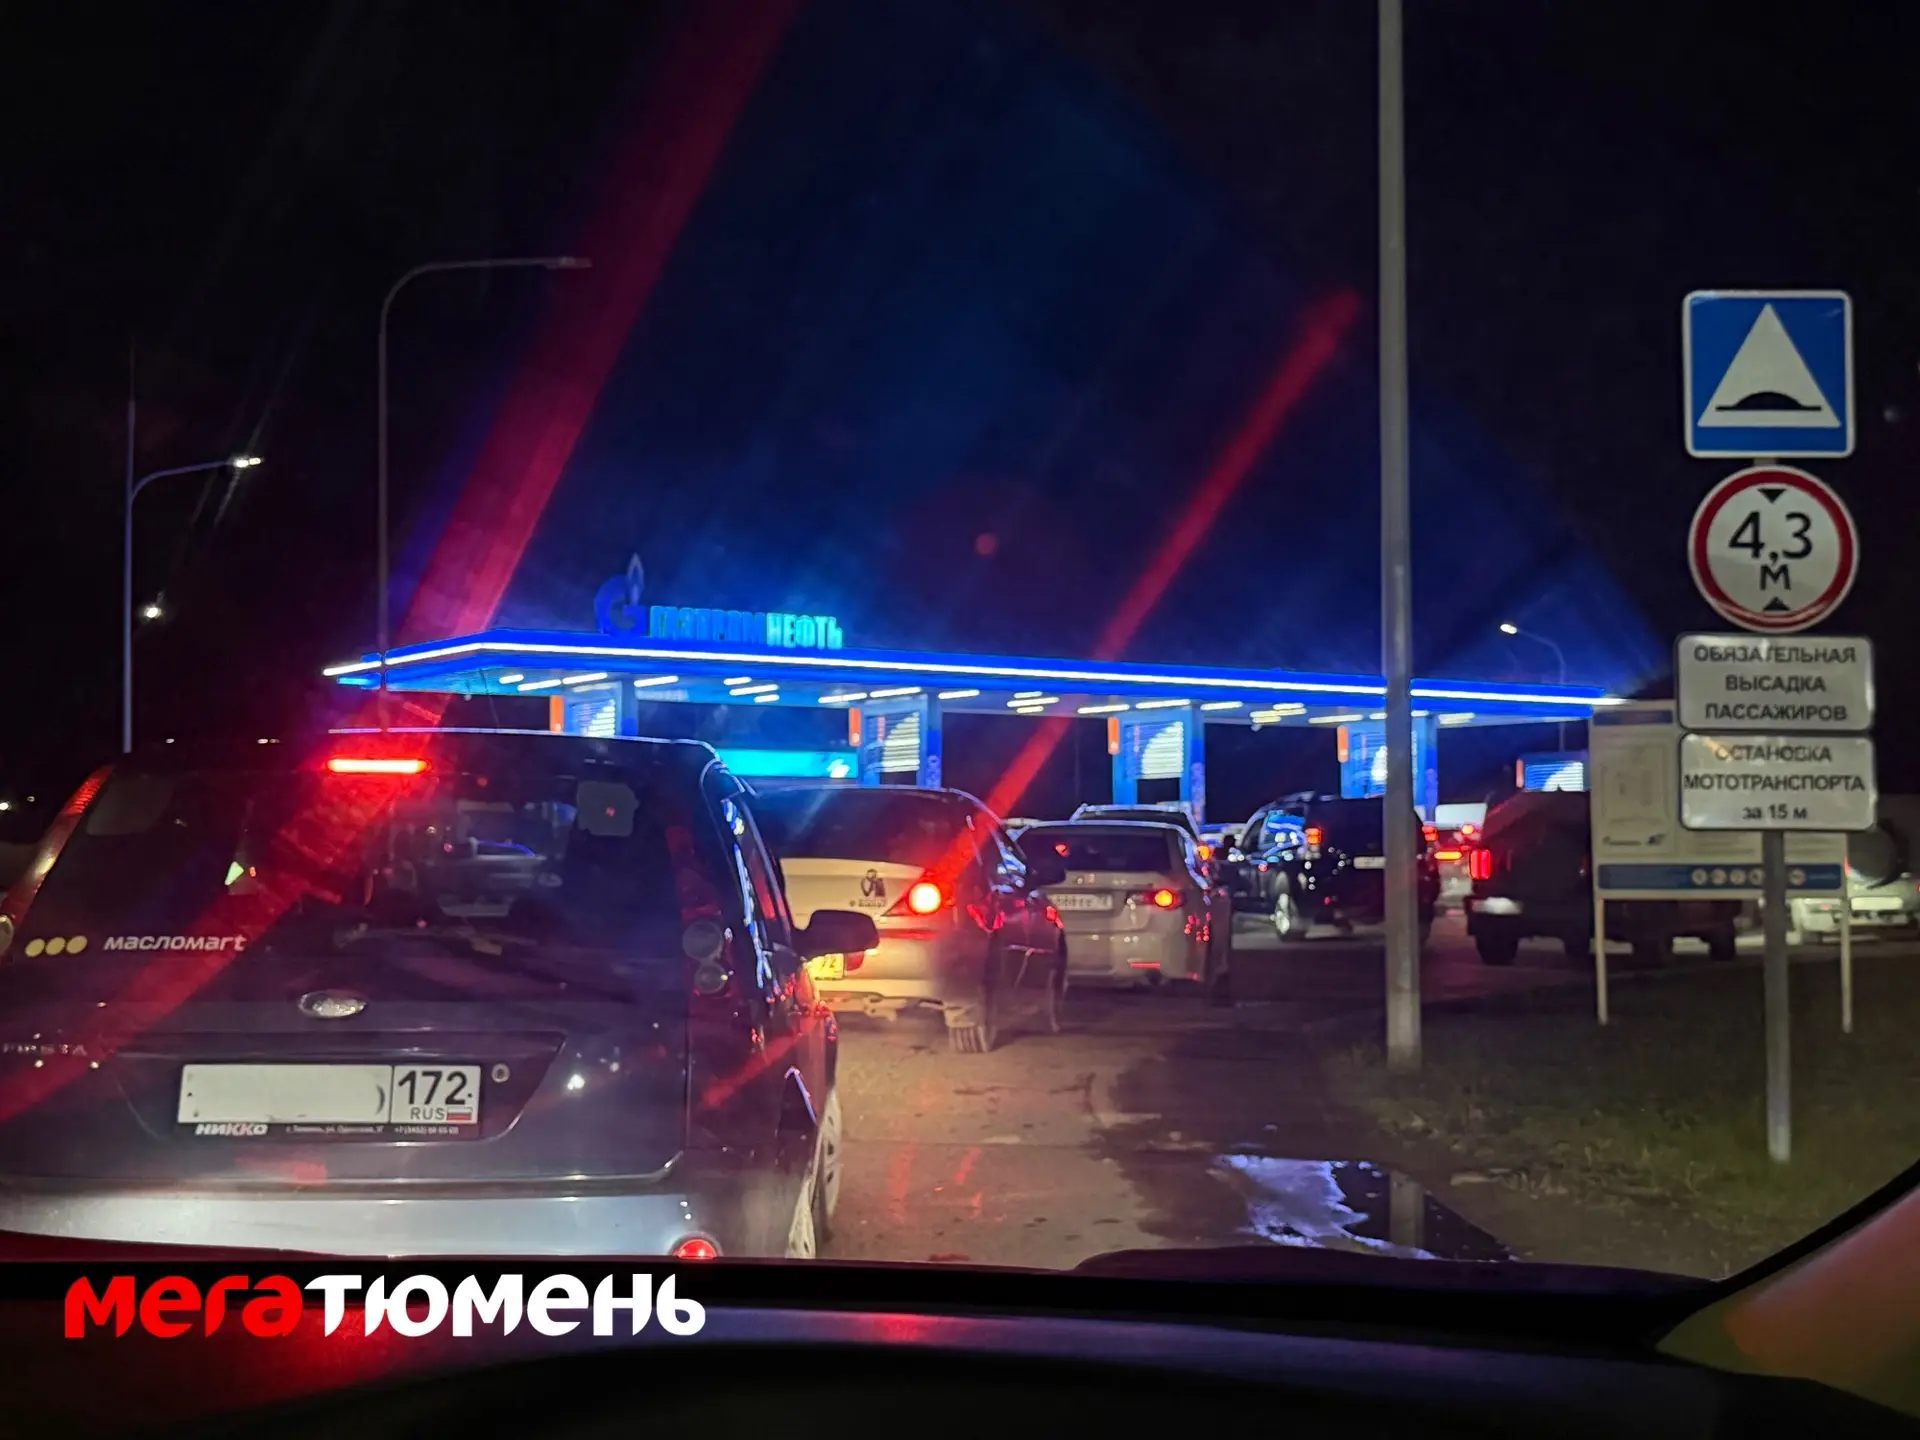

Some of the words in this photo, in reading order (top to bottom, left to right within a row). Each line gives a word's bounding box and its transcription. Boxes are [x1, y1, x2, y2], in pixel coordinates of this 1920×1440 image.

[1728, 511, 1813, 564] 4,3
[1725, 674, 1826, 693] ВЫСАДКА
[1705, 703, 1848, 721] ПАССАЖИРОВ
[1715, 744, 1832, 762] ОСТАНОВКА
[1684, 773, 1866, 791] МОТОТРАНСПОРТА
[1742, 806, 1763, 820] за
[1768, 803, 1788, 820] 15
[398, 1070, 467, 1105] 172
[410, 1107, 445, 1120] RUS
